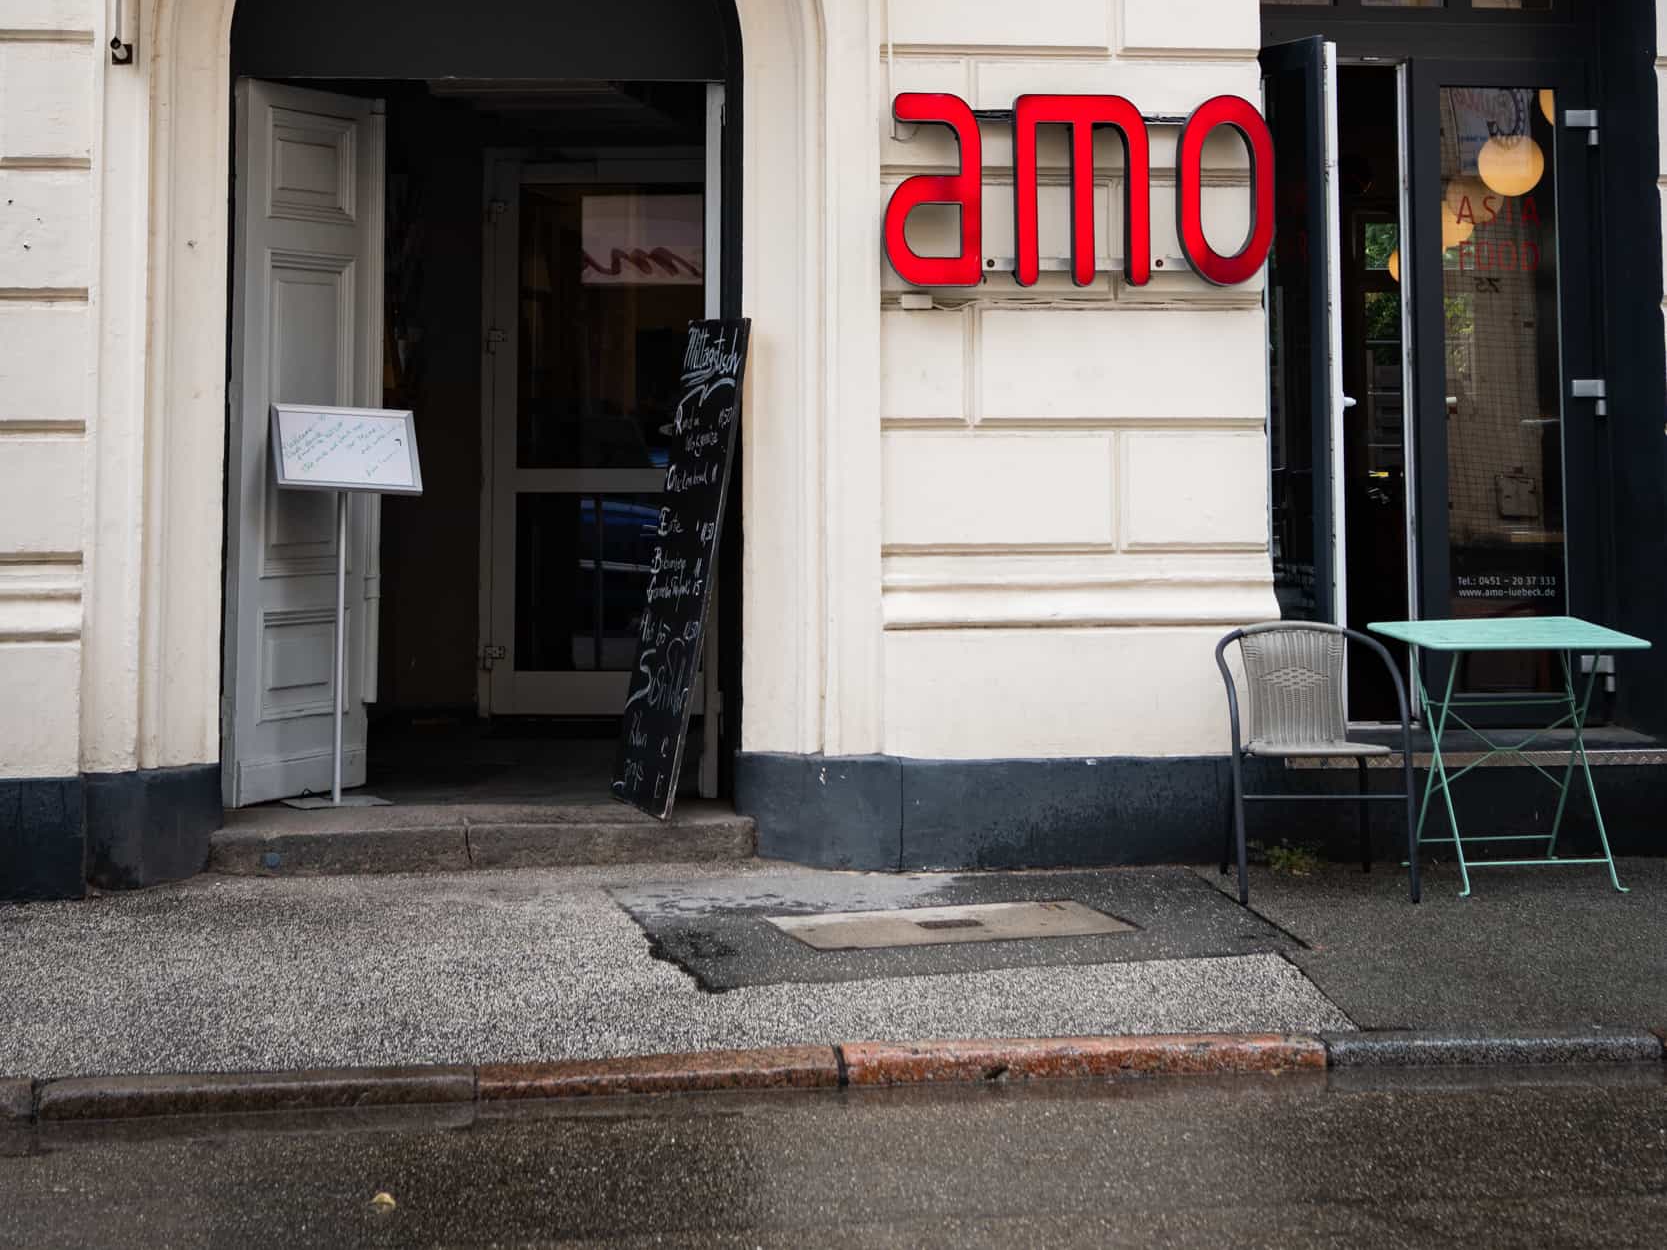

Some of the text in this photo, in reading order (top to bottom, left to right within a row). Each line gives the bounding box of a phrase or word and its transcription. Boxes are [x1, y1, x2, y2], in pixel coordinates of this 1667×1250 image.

[884, 93, 1275, 286] amo
[1456, 196, 1541, 227] ASIA
[1458, 240, 1540, 271] FOOD
[1457, 576, 1476, 586] Tel.:
[1479, 576, 1501, 586] 0451
[1512, 576, 1524, 586] 20
[1525, 576, 1537, 586] 37
[1458, 588, 1556, 598] www.amo-luebeck.de
